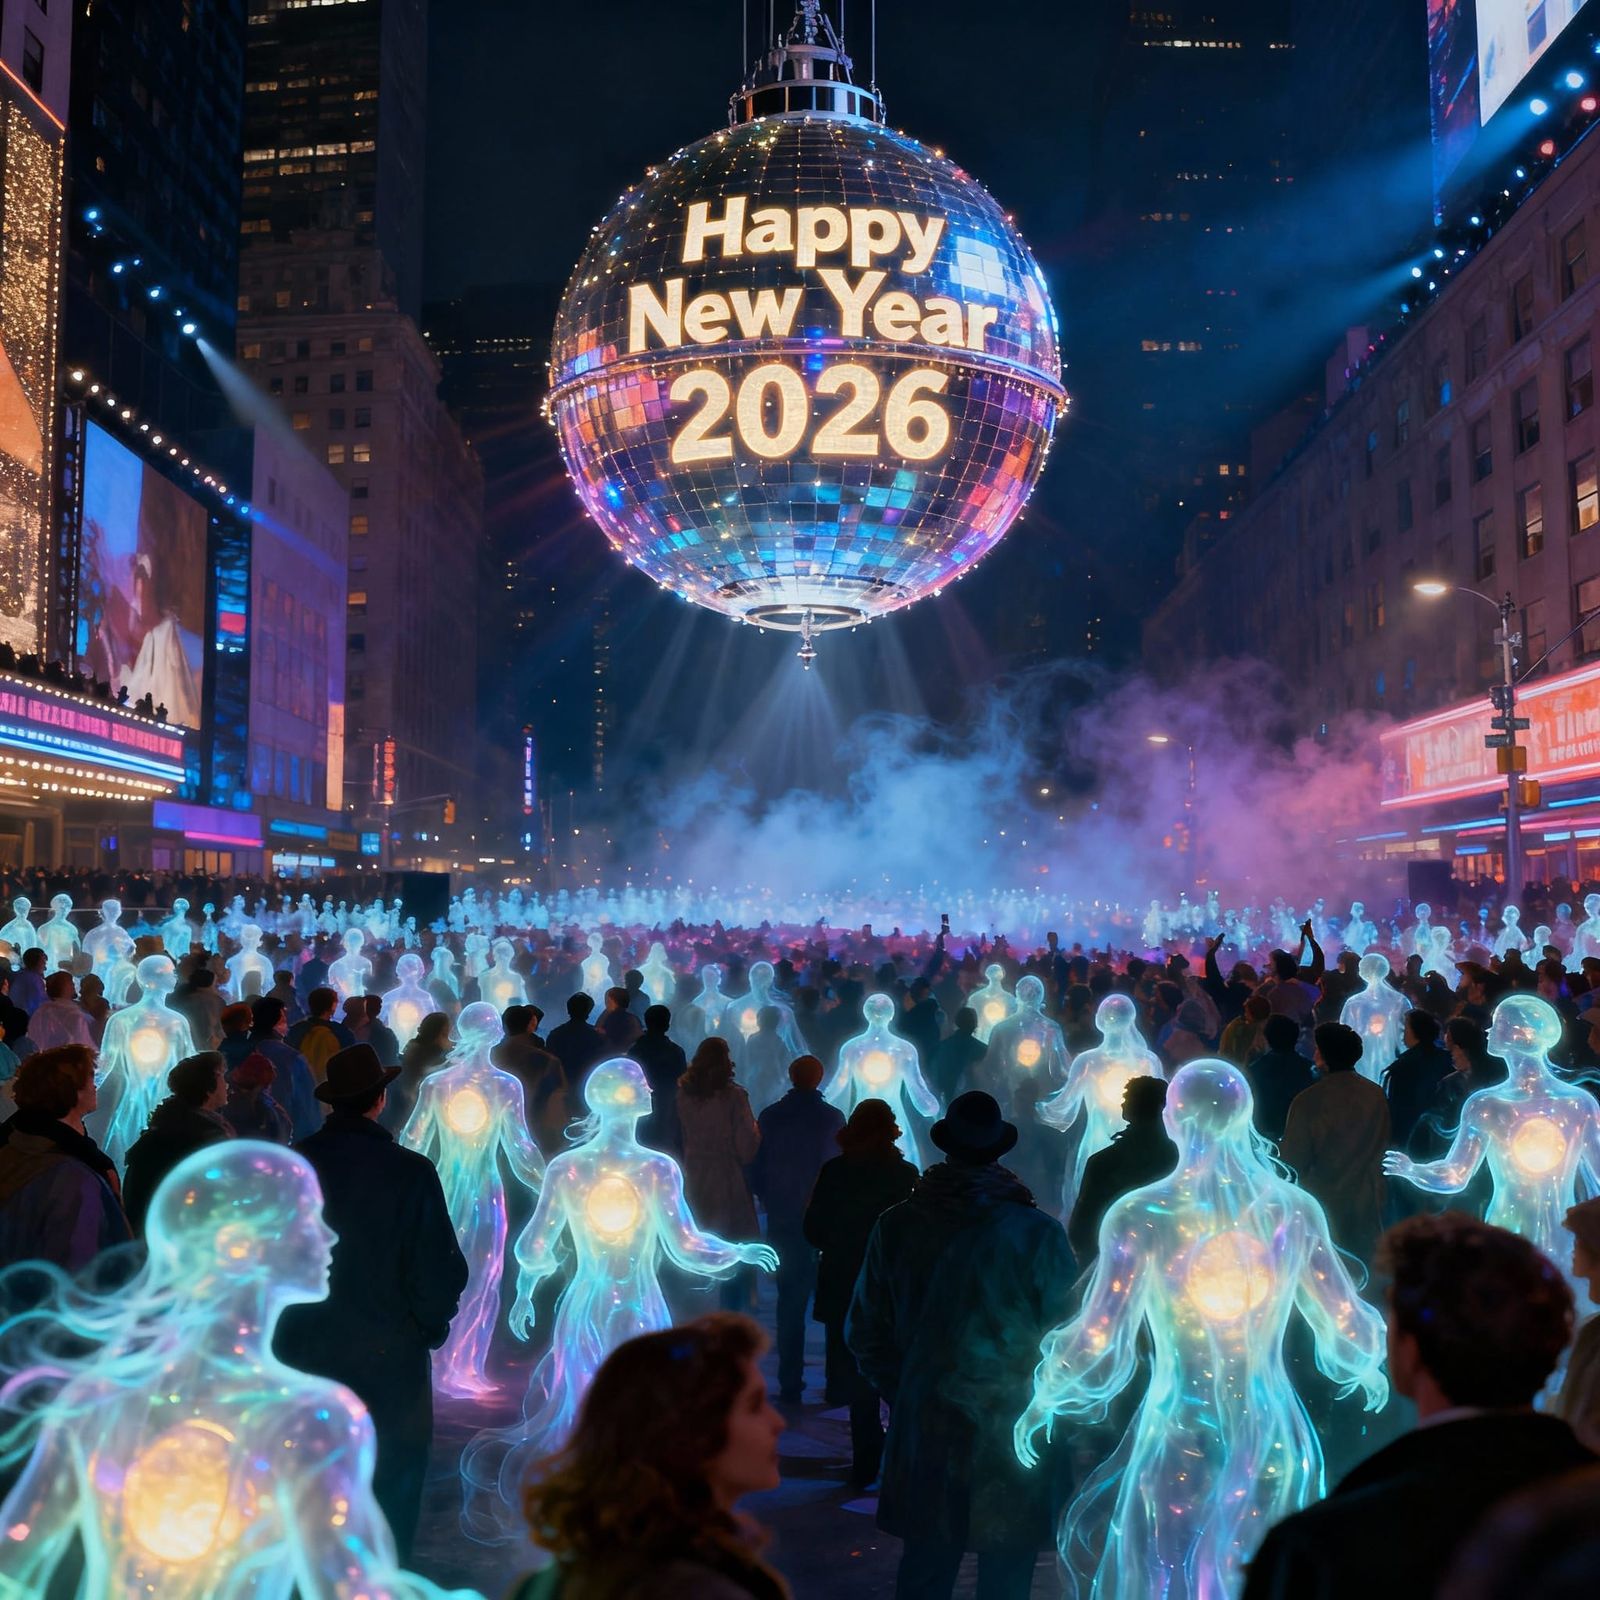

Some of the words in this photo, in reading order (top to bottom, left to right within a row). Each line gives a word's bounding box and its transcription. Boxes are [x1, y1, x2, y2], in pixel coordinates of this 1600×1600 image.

[683, 195, 946, 273] Happy
[629, 277, 803, 352] New
[817, 269, 998, 350] Year
[669, 363, 950, 463] 2026
